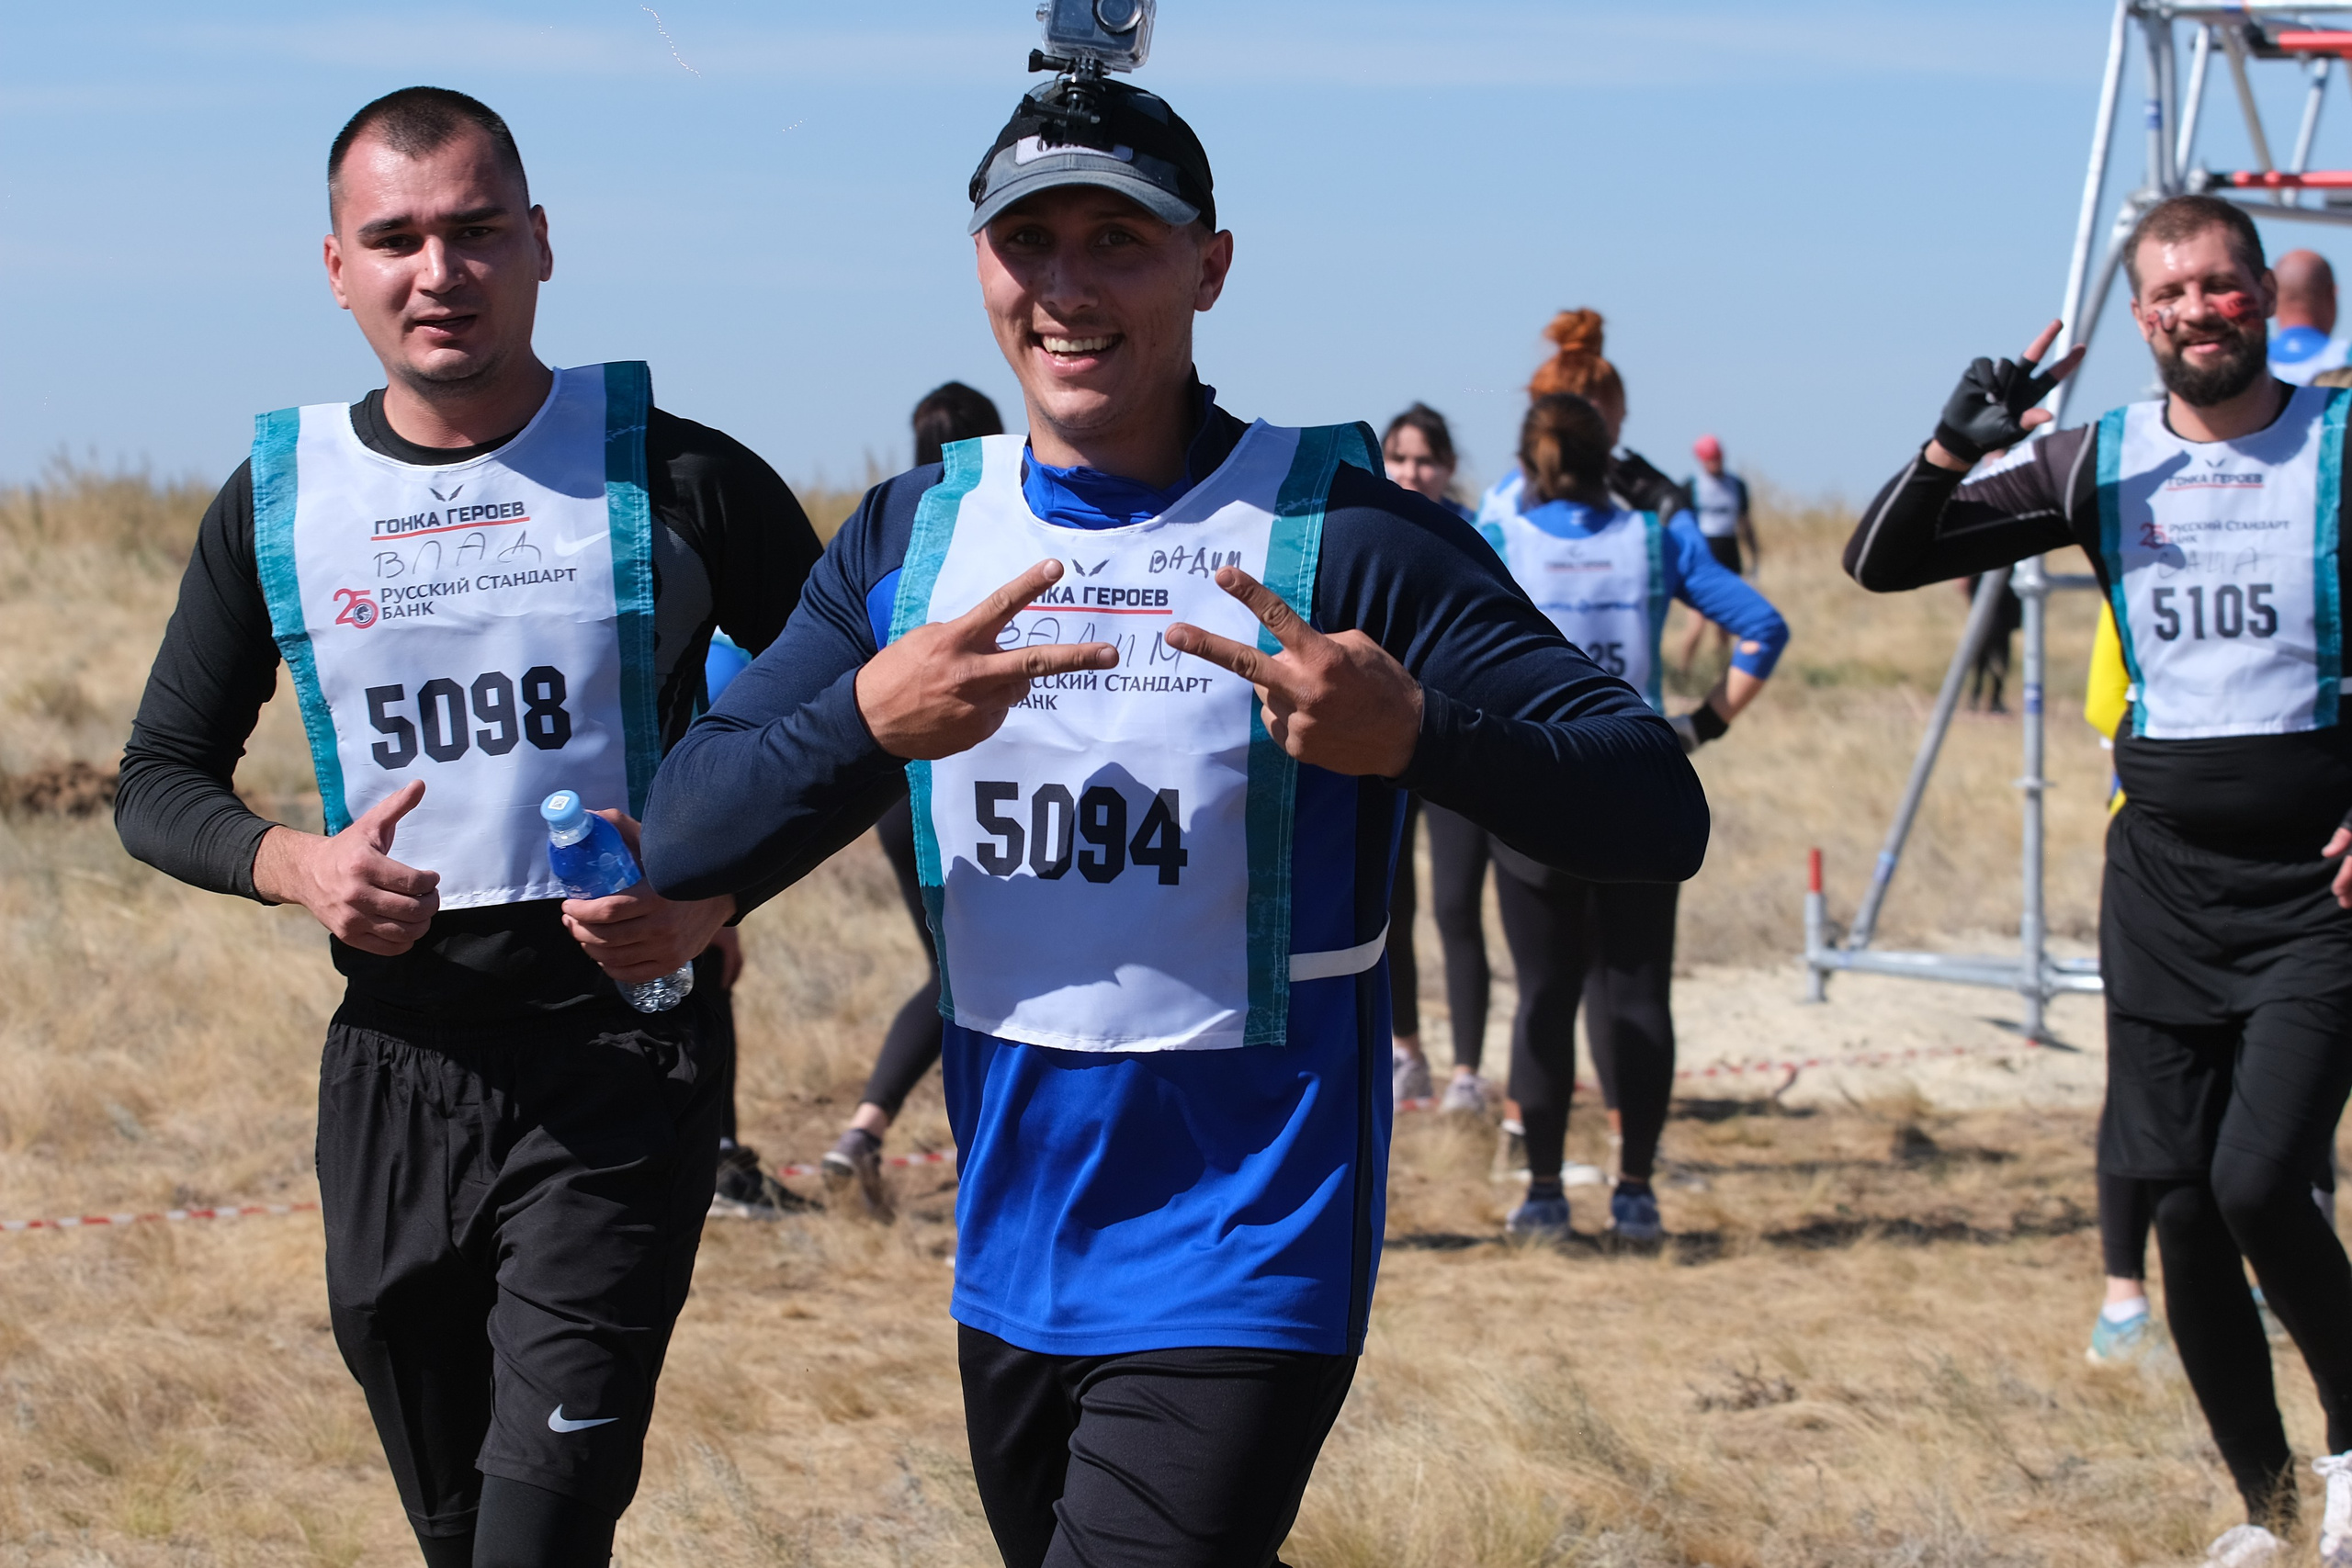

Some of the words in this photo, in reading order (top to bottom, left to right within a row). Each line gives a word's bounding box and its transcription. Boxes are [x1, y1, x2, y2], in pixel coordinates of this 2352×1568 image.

[374, 511, 441, 535] ГОНКА
[447, 501, 526, 525] ГЕРОЕВ
[373, 530, 542, 579] ВЛАД
[333, 588, 379, 630] 25
[380, 577, 470, 604] РУССКИЙ
[476, 568, 578, 592] СТАНДАРТ
[381, 601, 435, 621] БАНК
[1083, 586, 1170, 607] ГЕРОЕВ
[2153, 583, 2278, 641] 5105
[1010, 694, 1059, 711] АНК
[1029, 671, 1098, 691] ССКИЙ
[1104, 673, 1214, 694] СТАНДАРТ
[366, 665, 572, 770] 5098
[975, 781, 1189, 886] 5094
